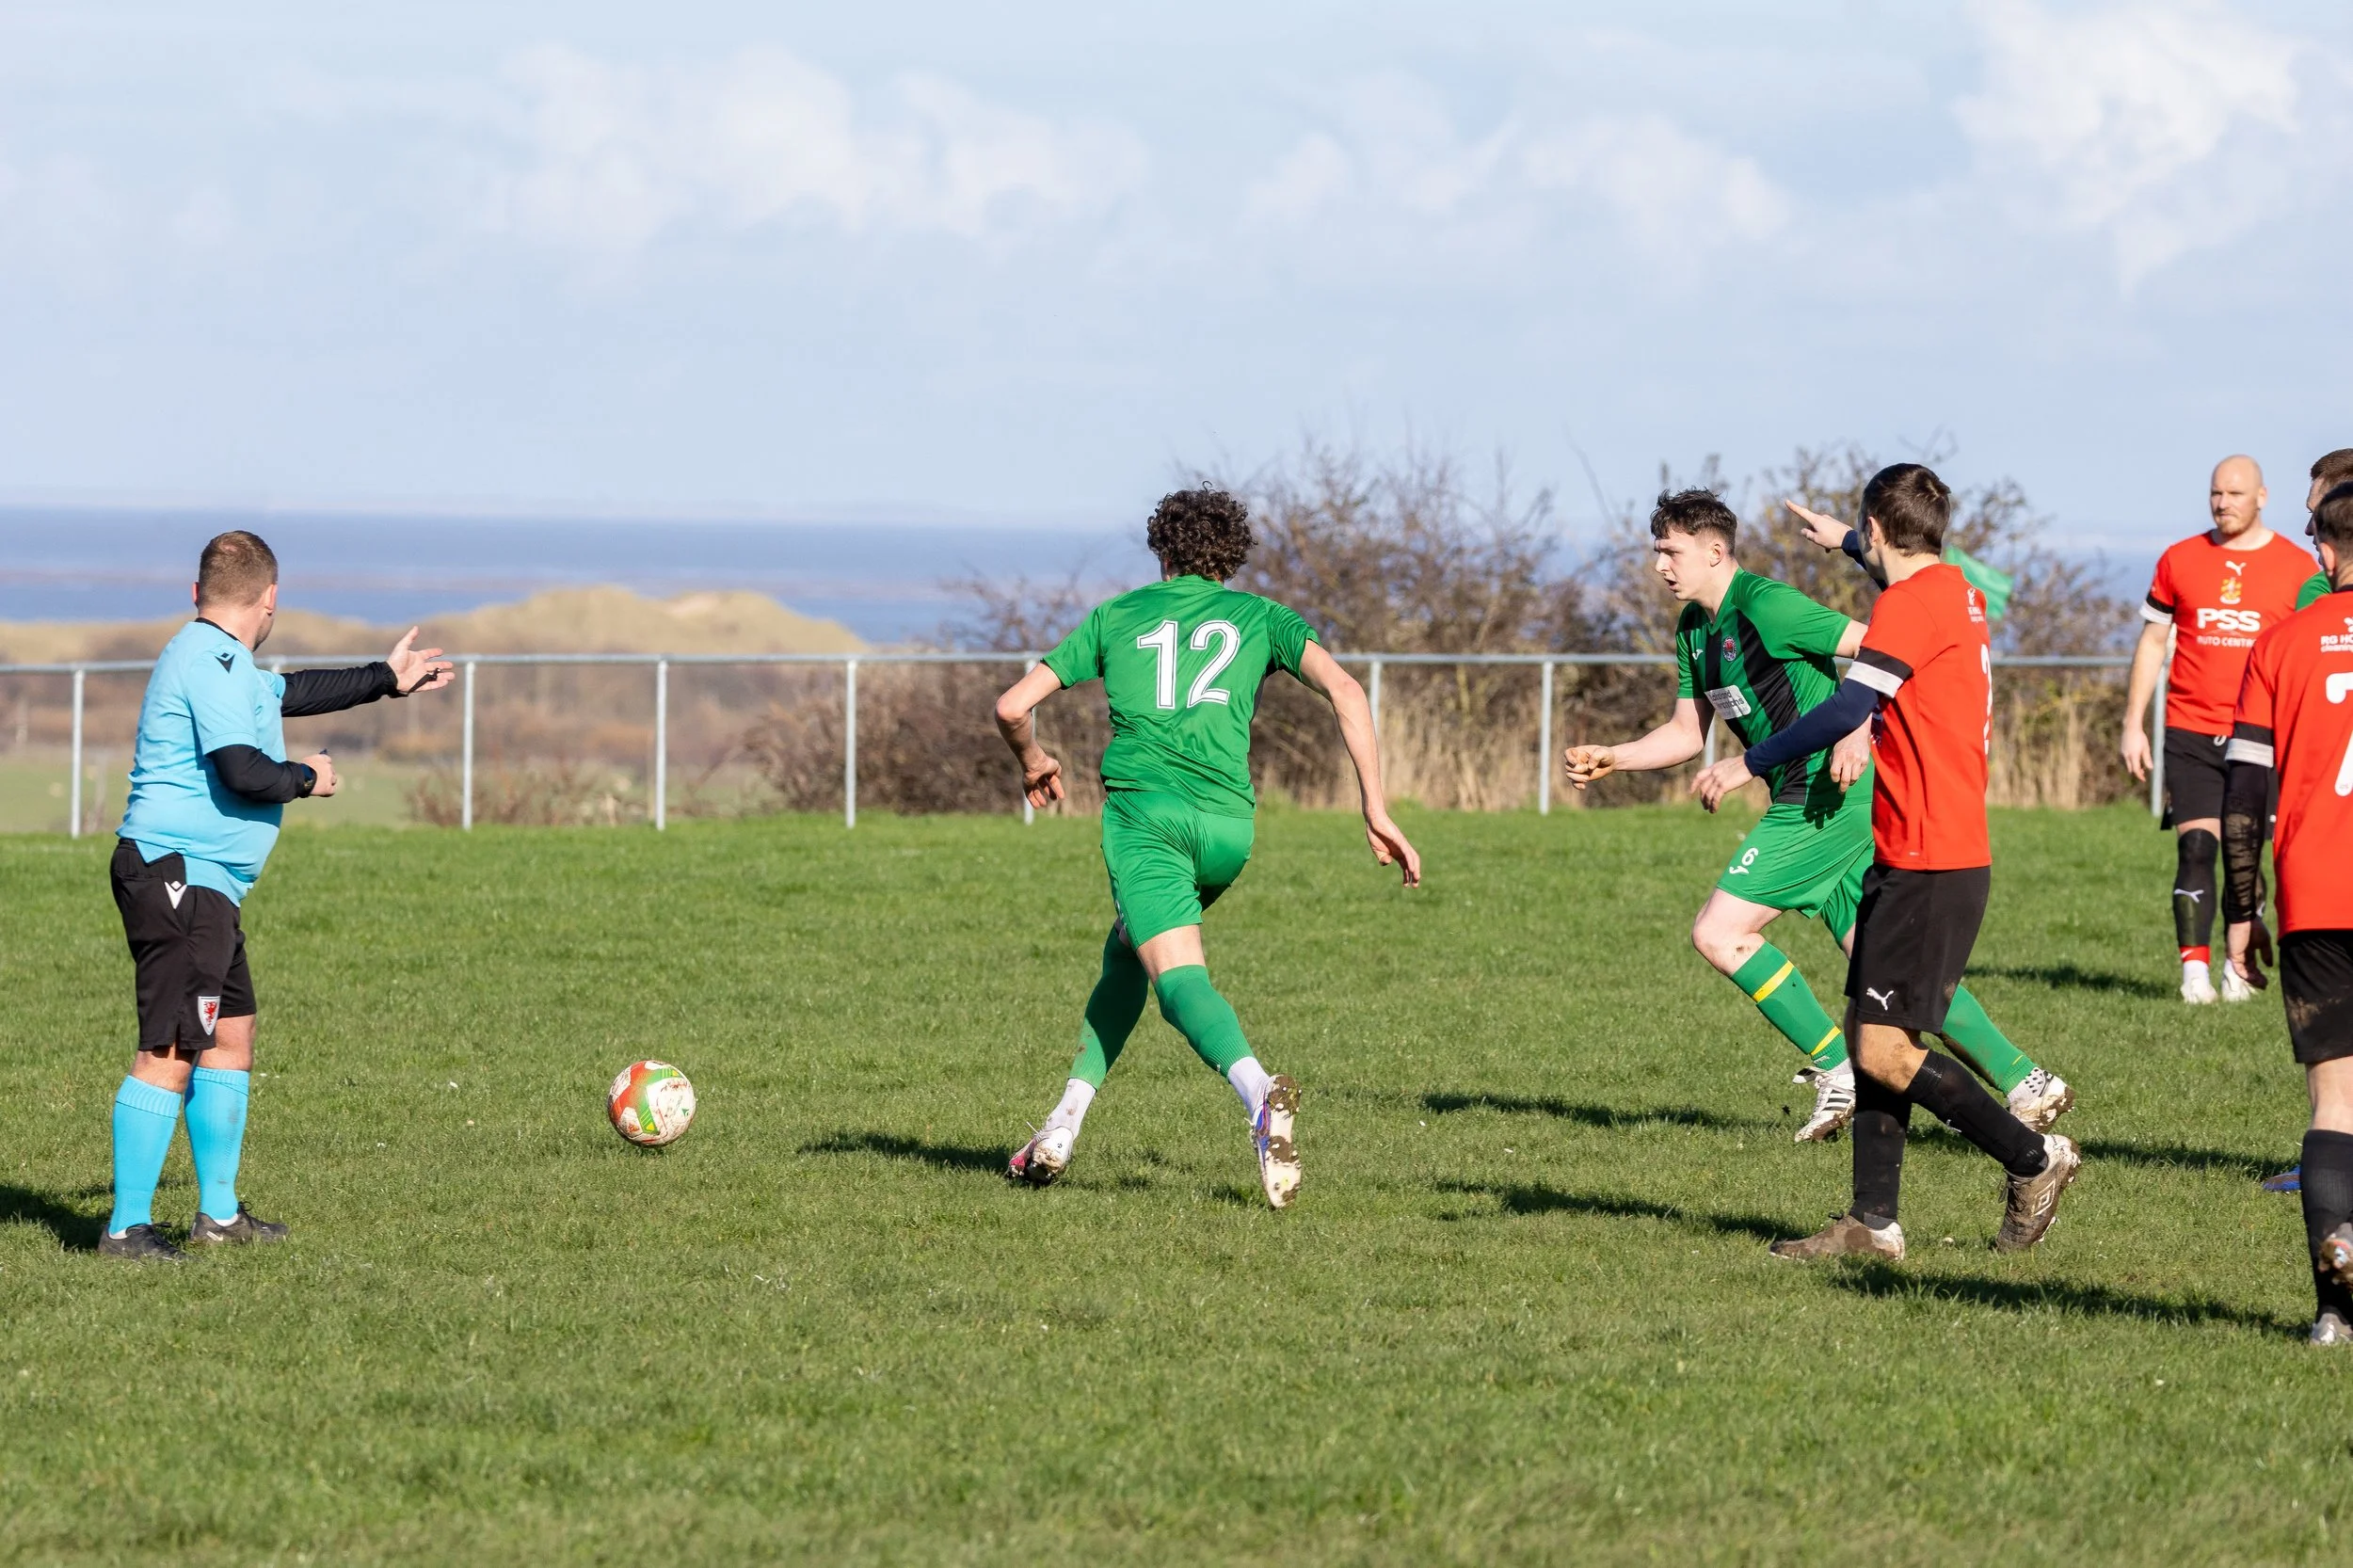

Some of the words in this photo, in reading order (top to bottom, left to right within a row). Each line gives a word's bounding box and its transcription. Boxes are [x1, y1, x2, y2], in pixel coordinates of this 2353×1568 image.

[2197, 608, 2262, 632] PSS
[1137, 619, 1241, 710] 12
[1741, 847, 1759, 866] 6
